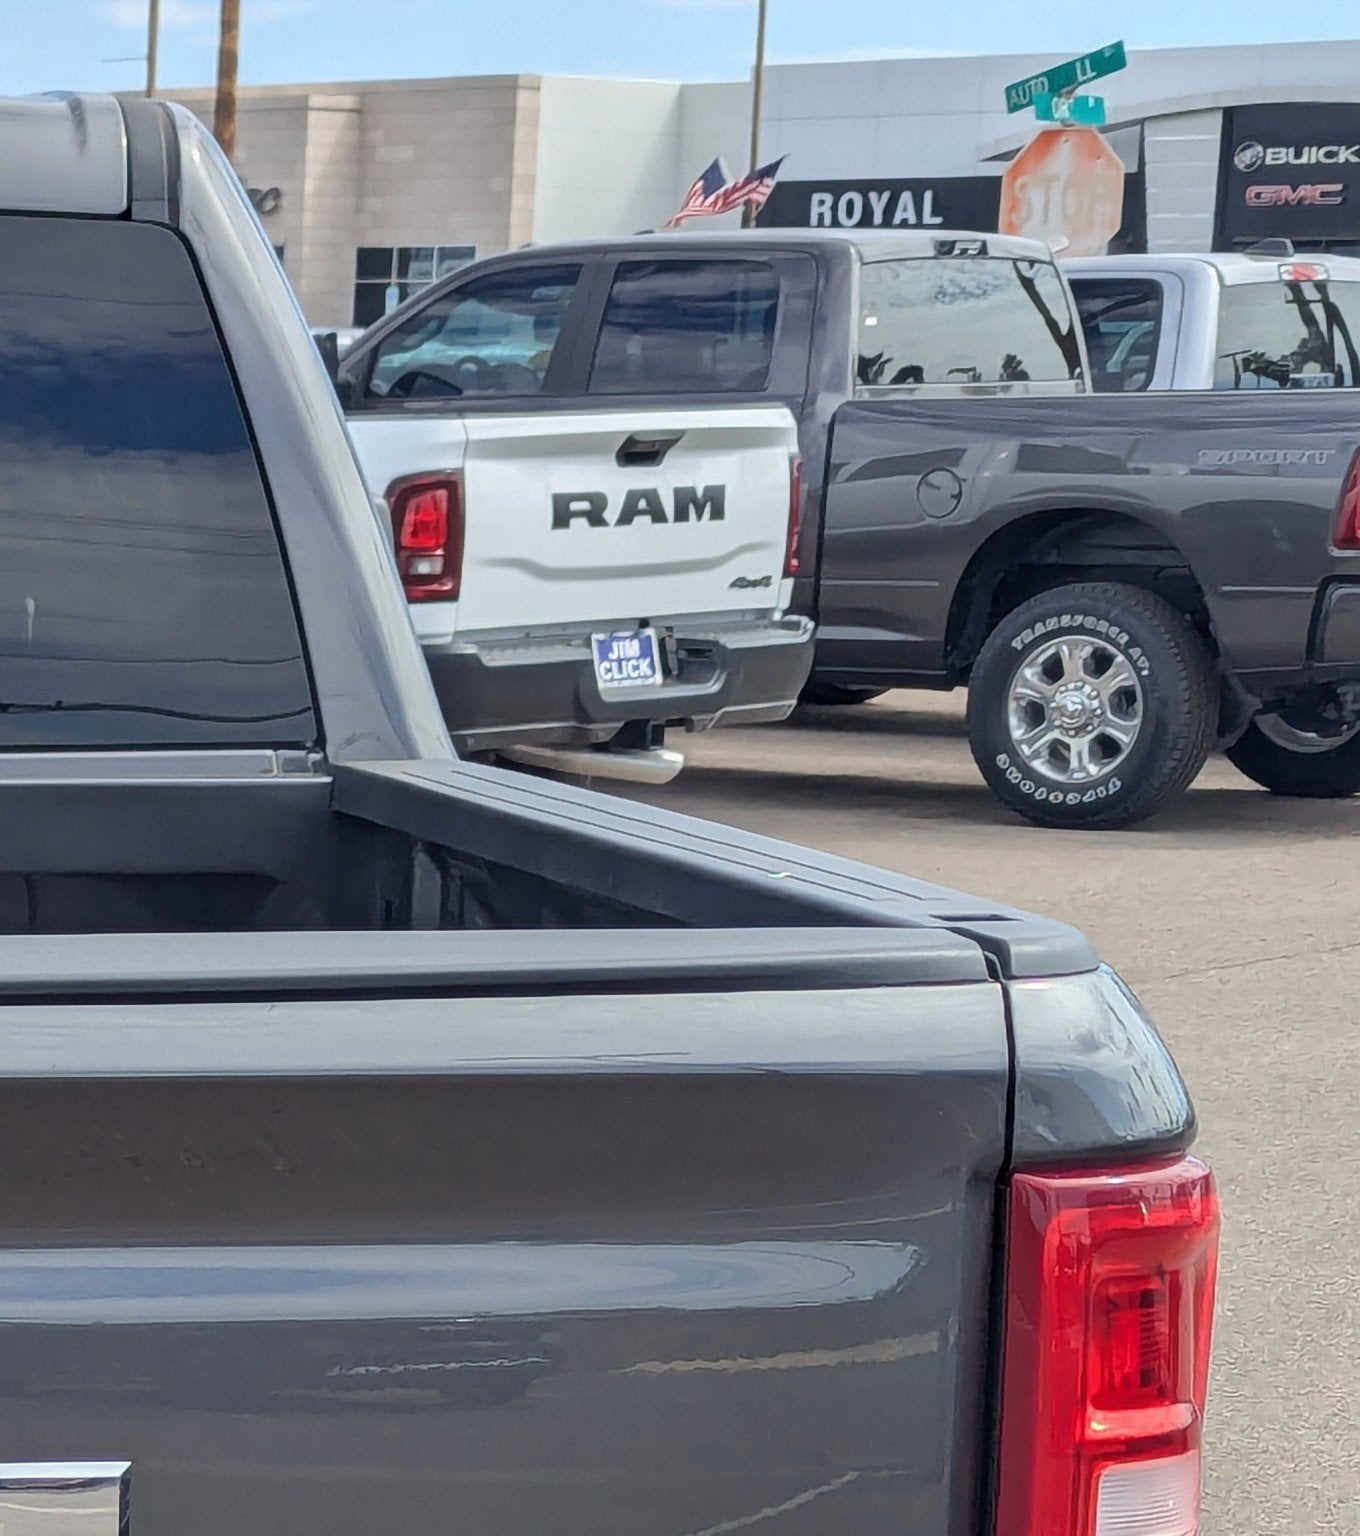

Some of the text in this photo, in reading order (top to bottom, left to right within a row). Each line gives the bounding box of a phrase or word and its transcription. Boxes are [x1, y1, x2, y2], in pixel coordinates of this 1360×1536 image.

[1265, 145, 1360, 164] BUICK
[1245, 184, 1343, 206] GMC
[810, 190, 943, 227] ROYAL
[551, 484, 726, 530] RAM
[608, 639, 640, 659] JIM
[599, 658, 652, 680] CLICK
